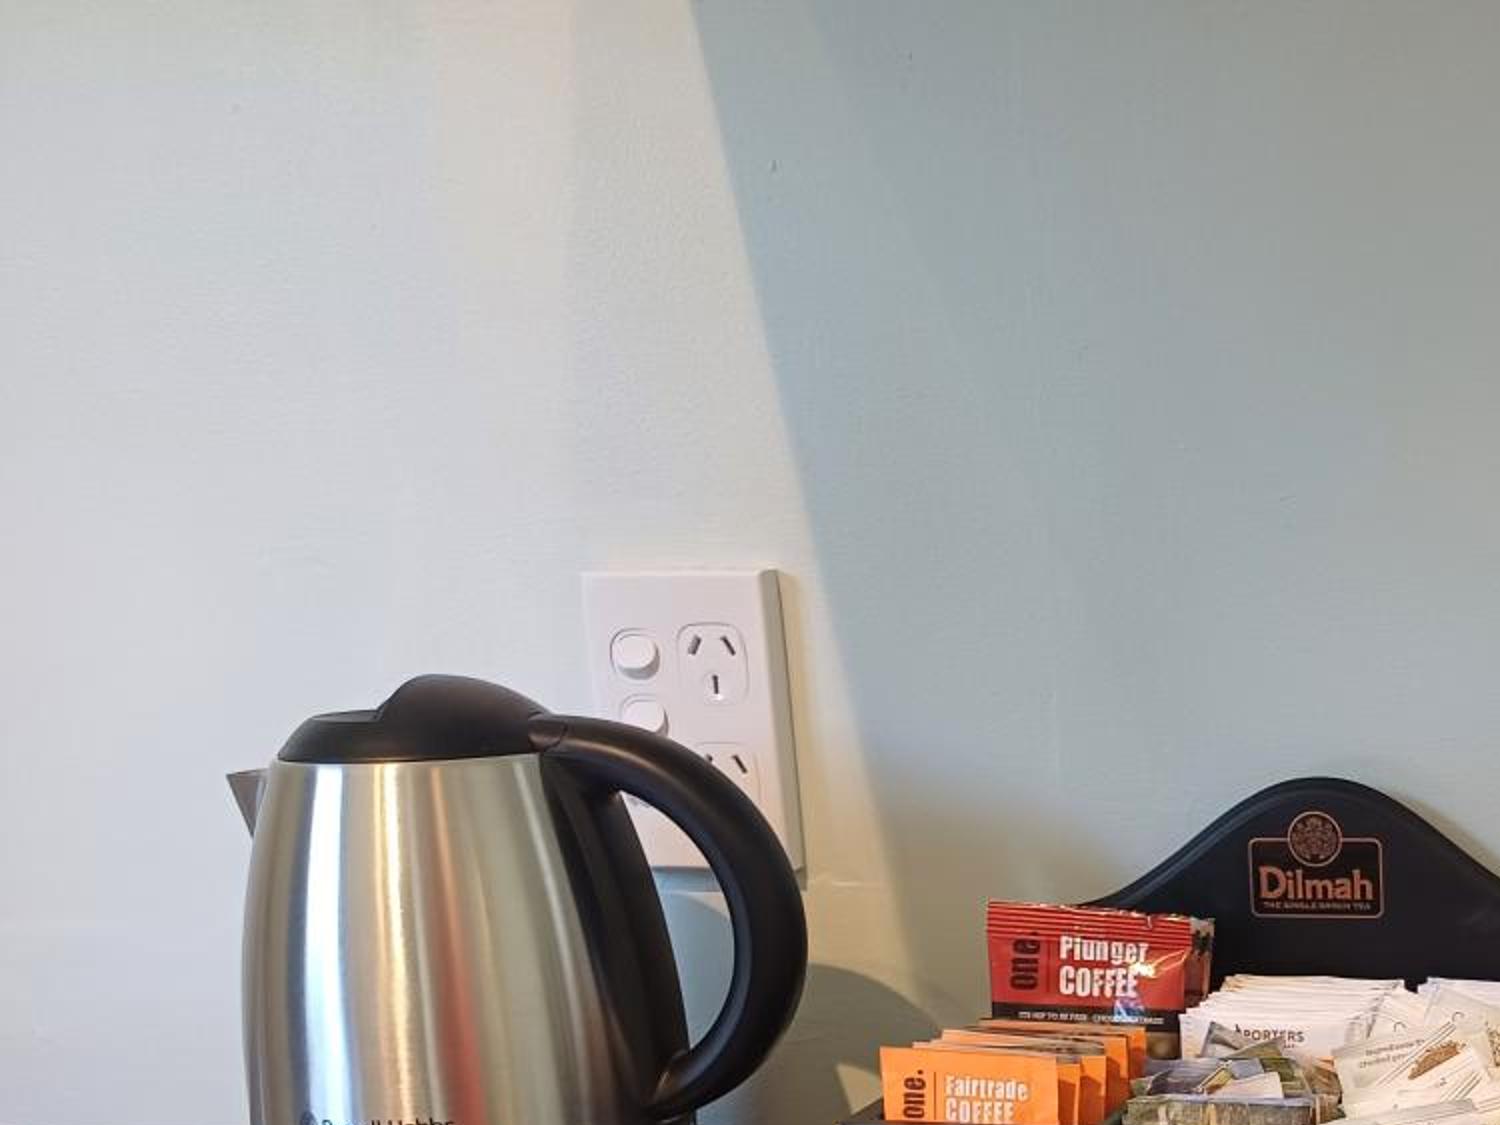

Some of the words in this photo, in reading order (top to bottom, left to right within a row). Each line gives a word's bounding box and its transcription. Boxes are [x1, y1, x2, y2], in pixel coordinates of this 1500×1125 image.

[1258, 866, 1373, 900] Dilmah
[1060, 936, 1149, 965] Plunger
[1059, 965, 1138, 998] COFFEE
[945, 1074, 1028, 1102] Fairtrade
[945, 1097, 1014, 1125] COFFEE
